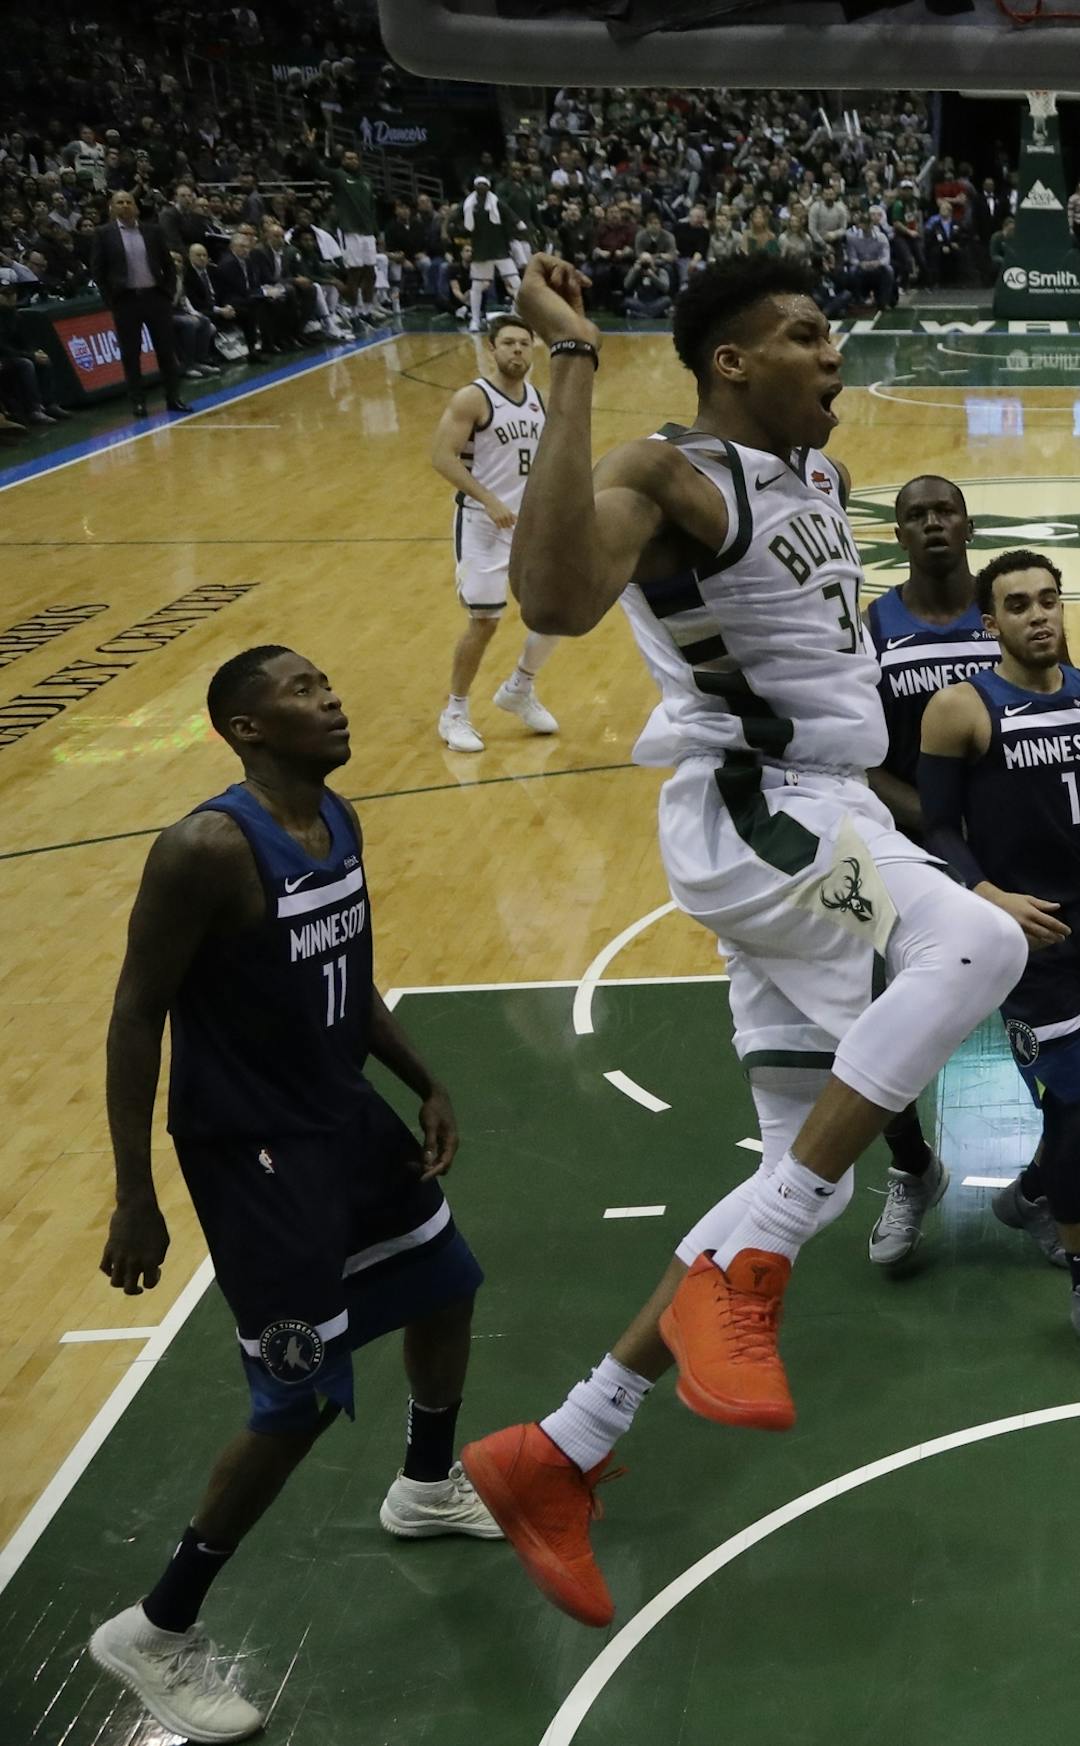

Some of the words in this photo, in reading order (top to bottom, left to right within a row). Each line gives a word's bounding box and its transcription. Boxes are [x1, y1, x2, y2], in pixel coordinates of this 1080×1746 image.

[89, 329, 121, 366] LUC
[494, 420, 540, 445] BUCK
[768, 513, 860, 585] BUCK
[95, 582, 261, 654] CENTER
[0, 659, 137, 748] ADLEY
[889, 661, 999, 698] MINNESOT
[1061, 771, 1080, 825] 1
[322, 954, 347, 1028] 11
